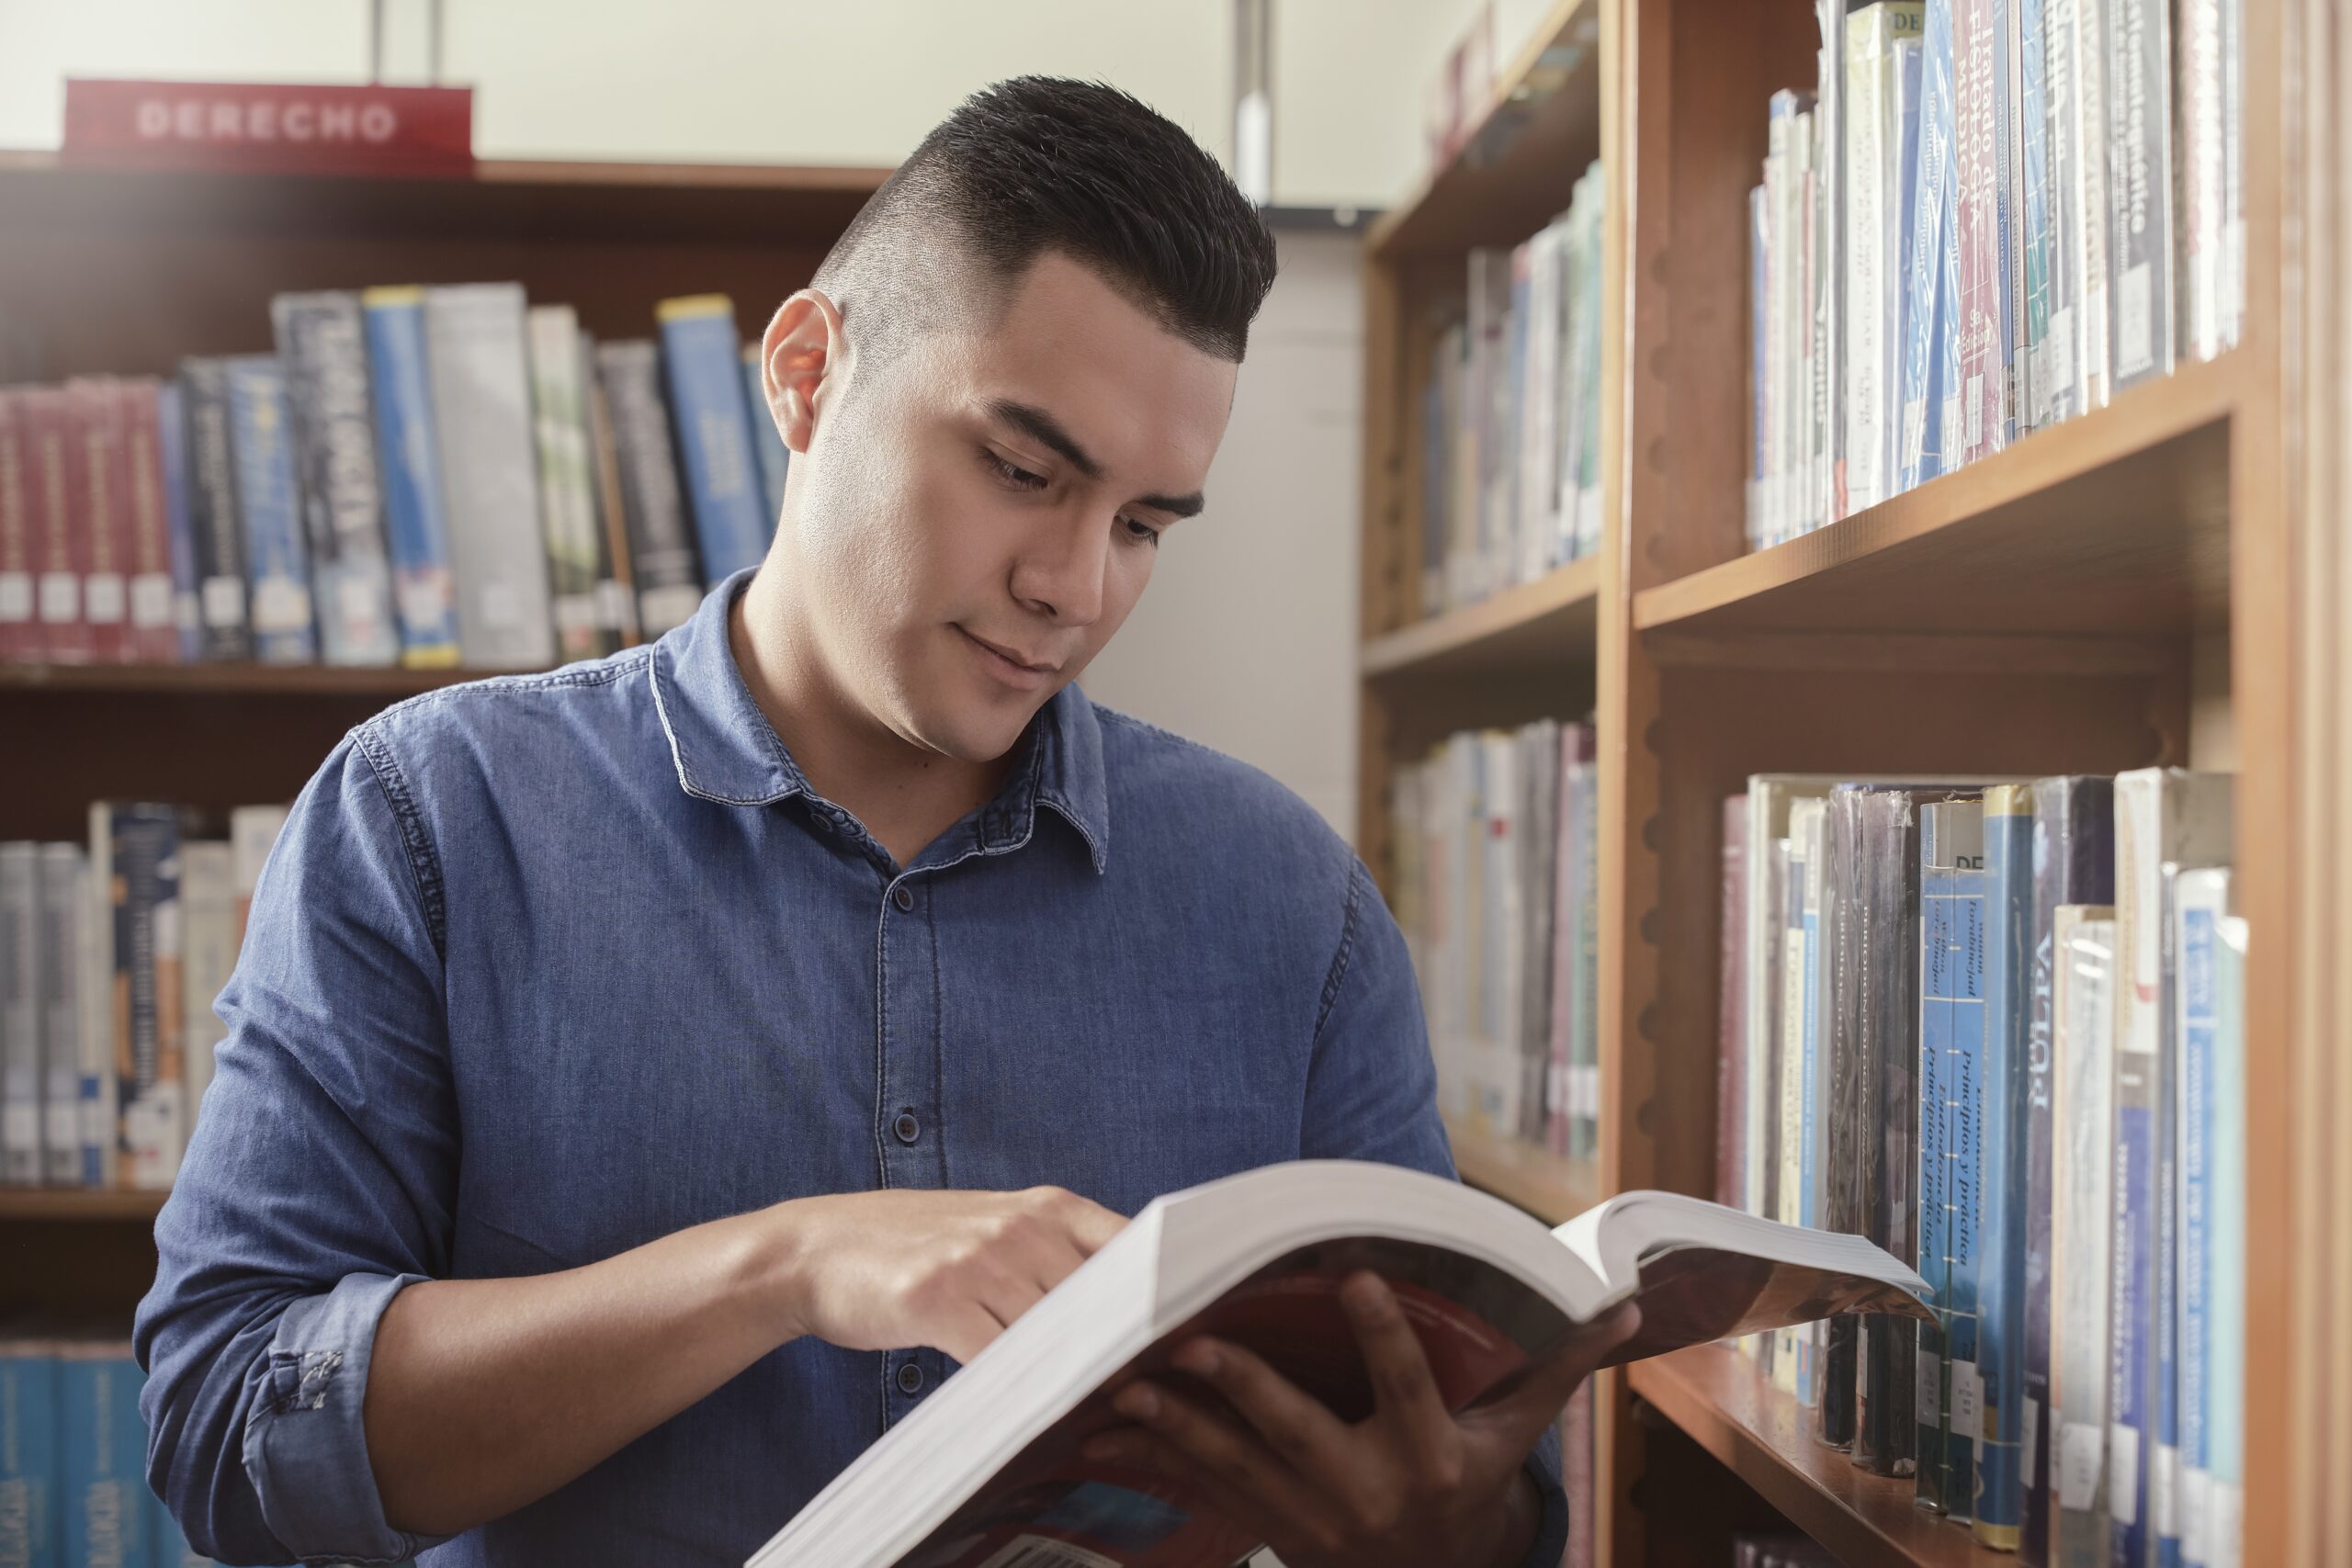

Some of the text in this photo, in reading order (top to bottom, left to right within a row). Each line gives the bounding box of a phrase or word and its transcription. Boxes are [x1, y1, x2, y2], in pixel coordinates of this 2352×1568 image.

[136, 101, 397, 141] DERECHO
[1982, 26, 1996, 205] Tratado de
[1967, 900, 1977, 997] Torabinejad
[2032, 929, 2052, 1111] PULPA
[1925, 1047, 1937, 1259] Principios y práctica
[1937, 1084, 1946, 1225] Endodoncia
[1959, 1050, 1973, 1267] Principios y práctica
